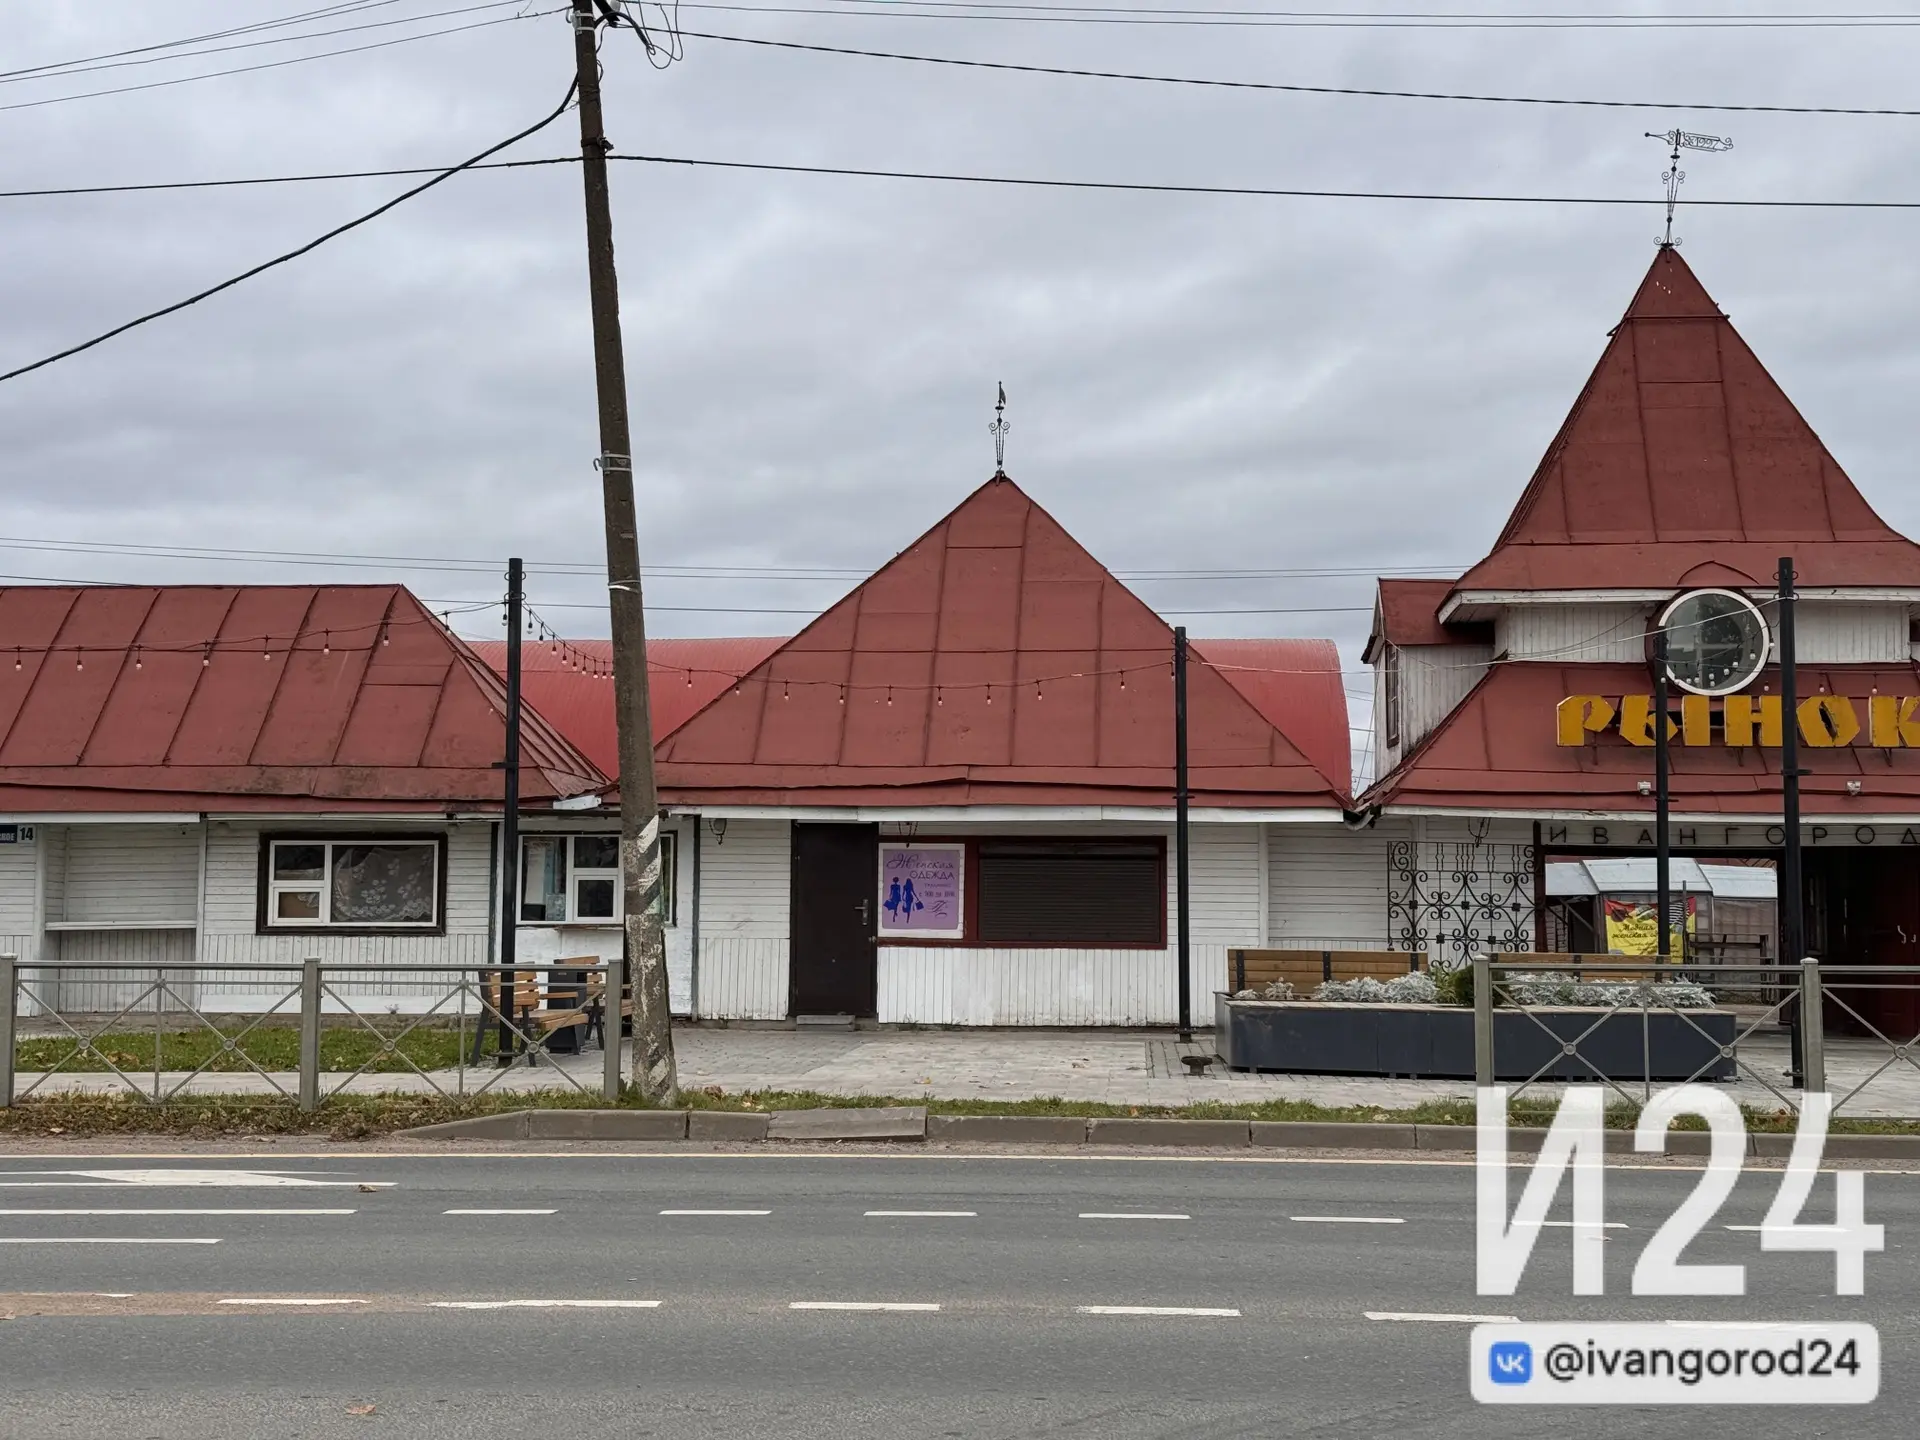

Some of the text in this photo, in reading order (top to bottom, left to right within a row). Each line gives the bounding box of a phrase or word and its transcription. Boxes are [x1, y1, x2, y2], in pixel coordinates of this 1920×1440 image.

[1556, 694, 1920, 748] РЫНОК
[20, 827, 33, 840] 14
[1549, 826, 1920, 847] ИВАНГОРОД
[910, 870, 954, 880] ОДЕЖДА
